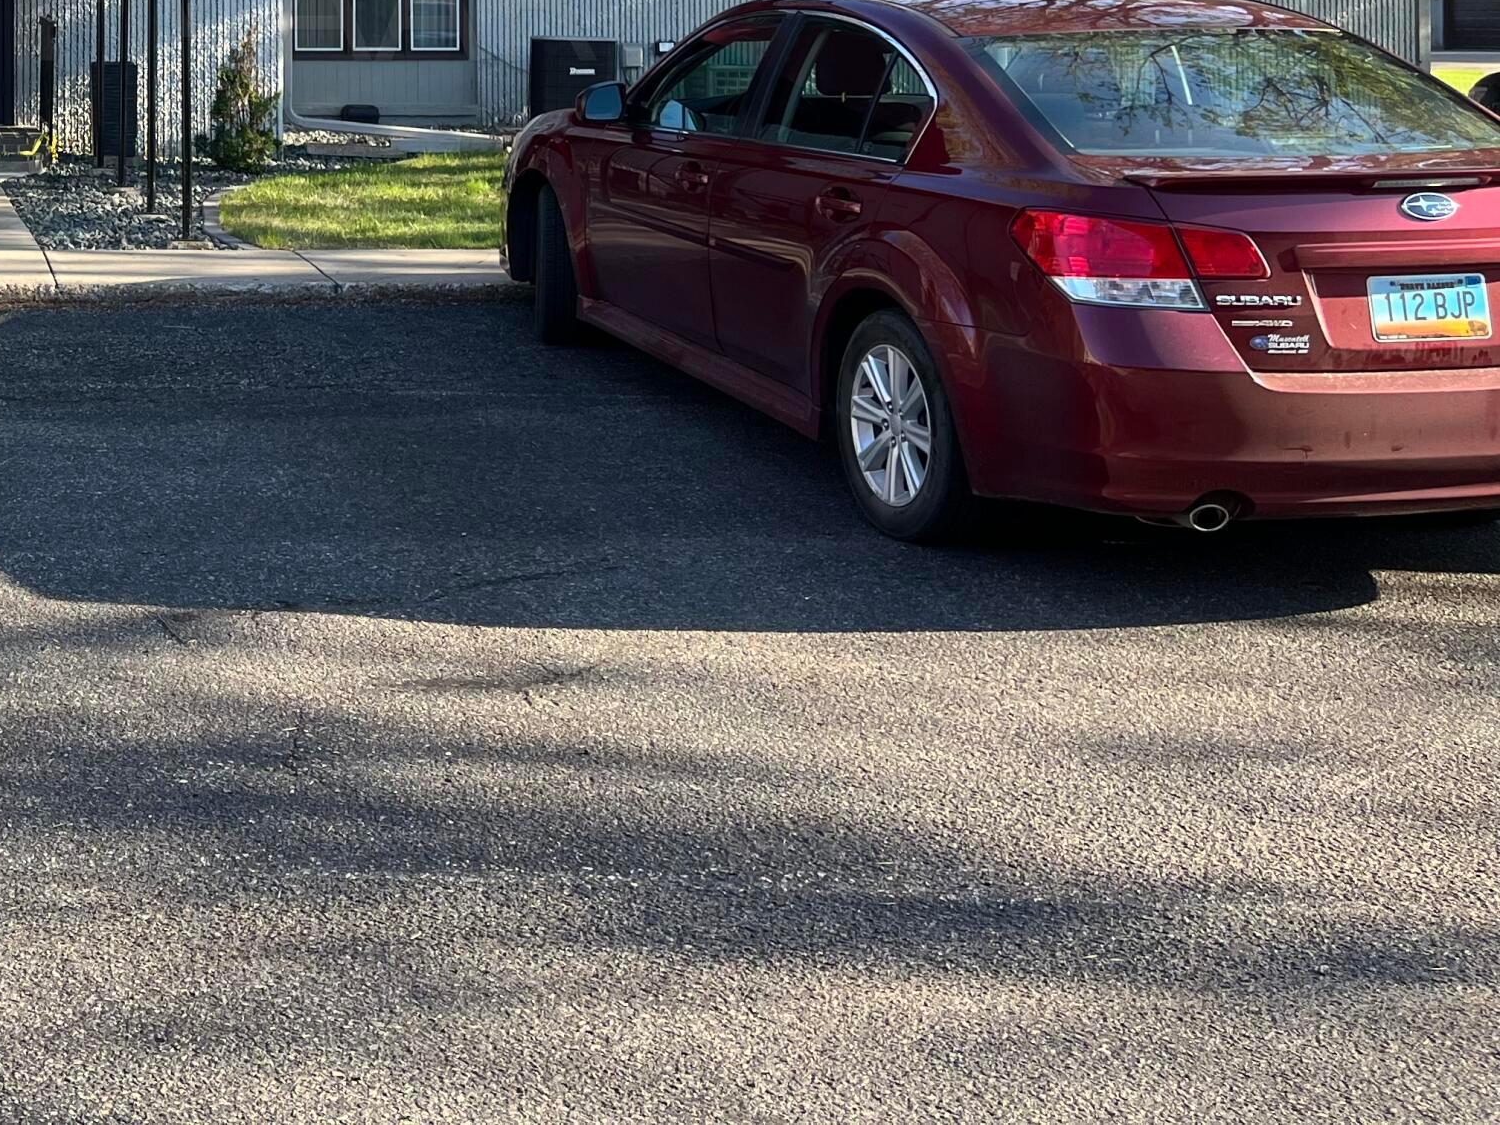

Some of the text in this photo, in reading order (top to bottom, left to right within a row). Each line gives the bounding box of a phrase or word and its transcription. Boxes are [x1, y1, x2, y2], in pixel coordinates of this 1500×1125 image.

[1215, 295, 1302, 306] SUBARU
[1385, 291, 1475, 322] 112 BJP
